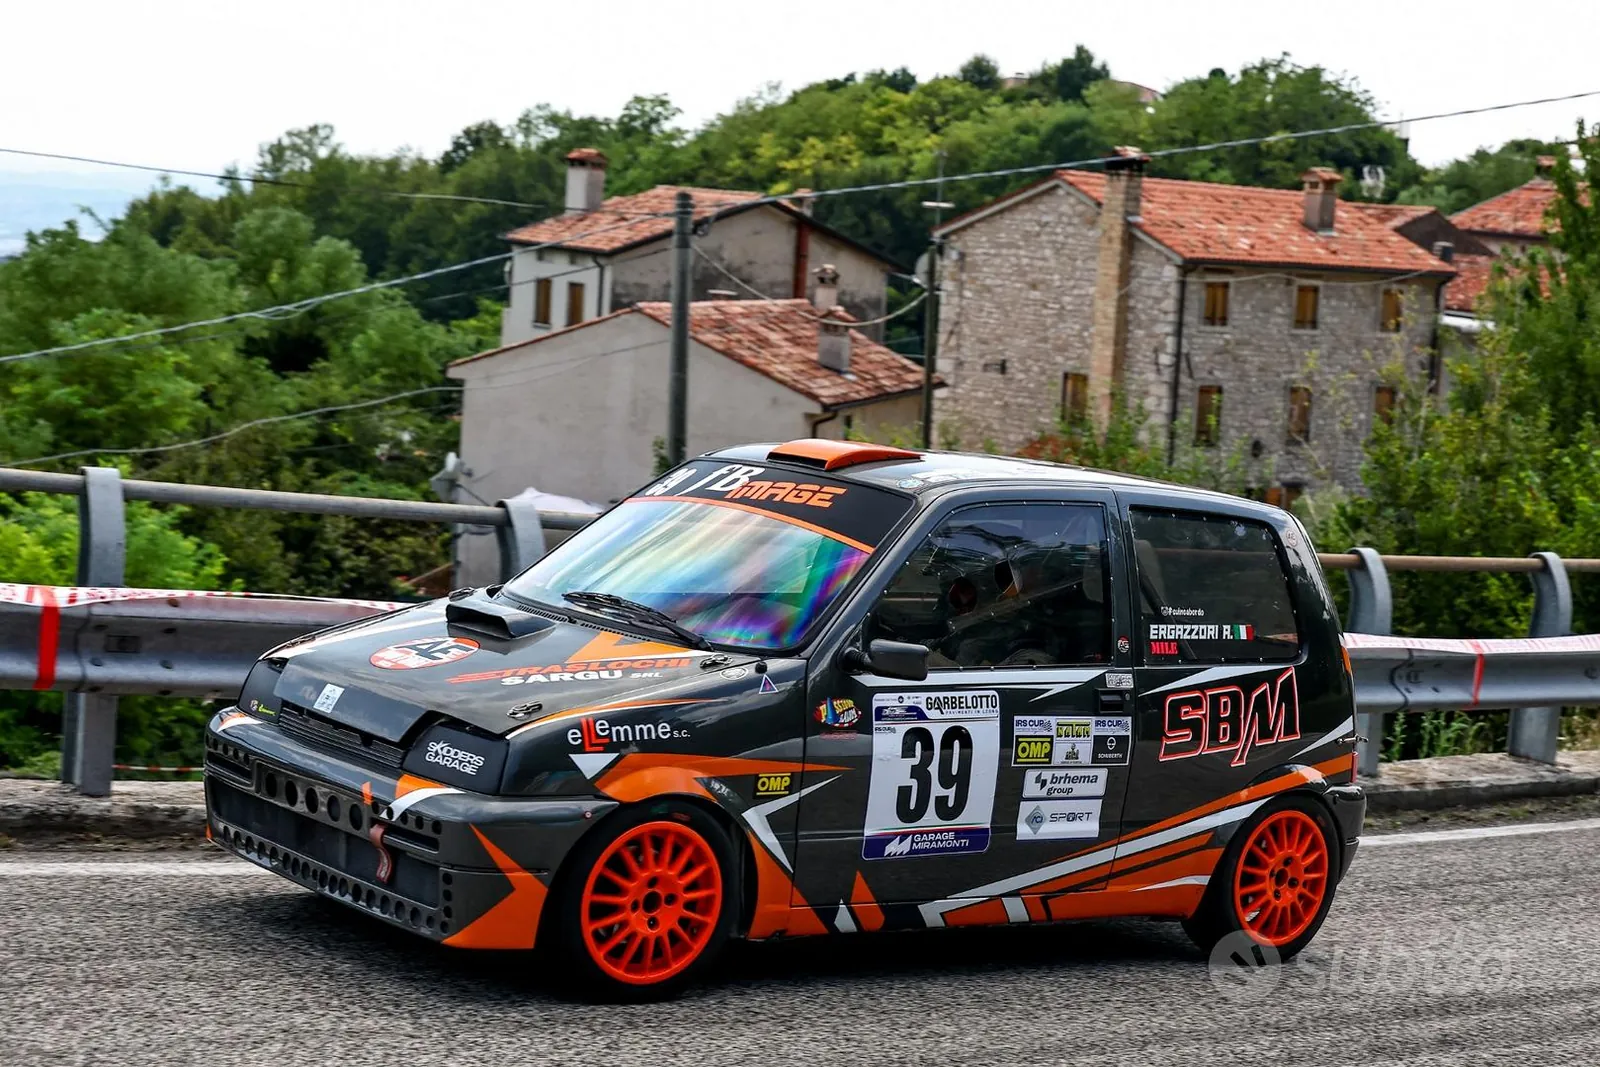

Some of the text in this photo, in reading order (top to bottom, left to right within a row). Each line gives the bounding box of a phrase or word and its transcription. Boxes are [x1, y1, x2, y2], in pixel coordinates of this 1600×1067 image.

[1149, 624, 1219, 639] ERGAZZORI
[478, 658, 692, 681] TRASLOCHI
[501, 669, 623, 686] SARGU
[925, 694, 998, 714] GARBELOTTO
[1015, 719, 1045, 727] IRS CUP
[1095, 719, 1123, 727] IRS CUP
[1158, 665, 1301, 767] SBM
[1018, 741, 1051, 758] OMP
[425, 751, 479, 776] GARAGE
[896, 725, 973, 824] 39
[1050, 773, 1098, 785] brhema
[756, 776, 791, 792] OMP
[1046, 786, 1074, 796] group
[1049, 811, 1093, 823] SPORT
[911, 839, 970, 850] MIRAMONTI
[913, 832, 955, 843] GARAGE
